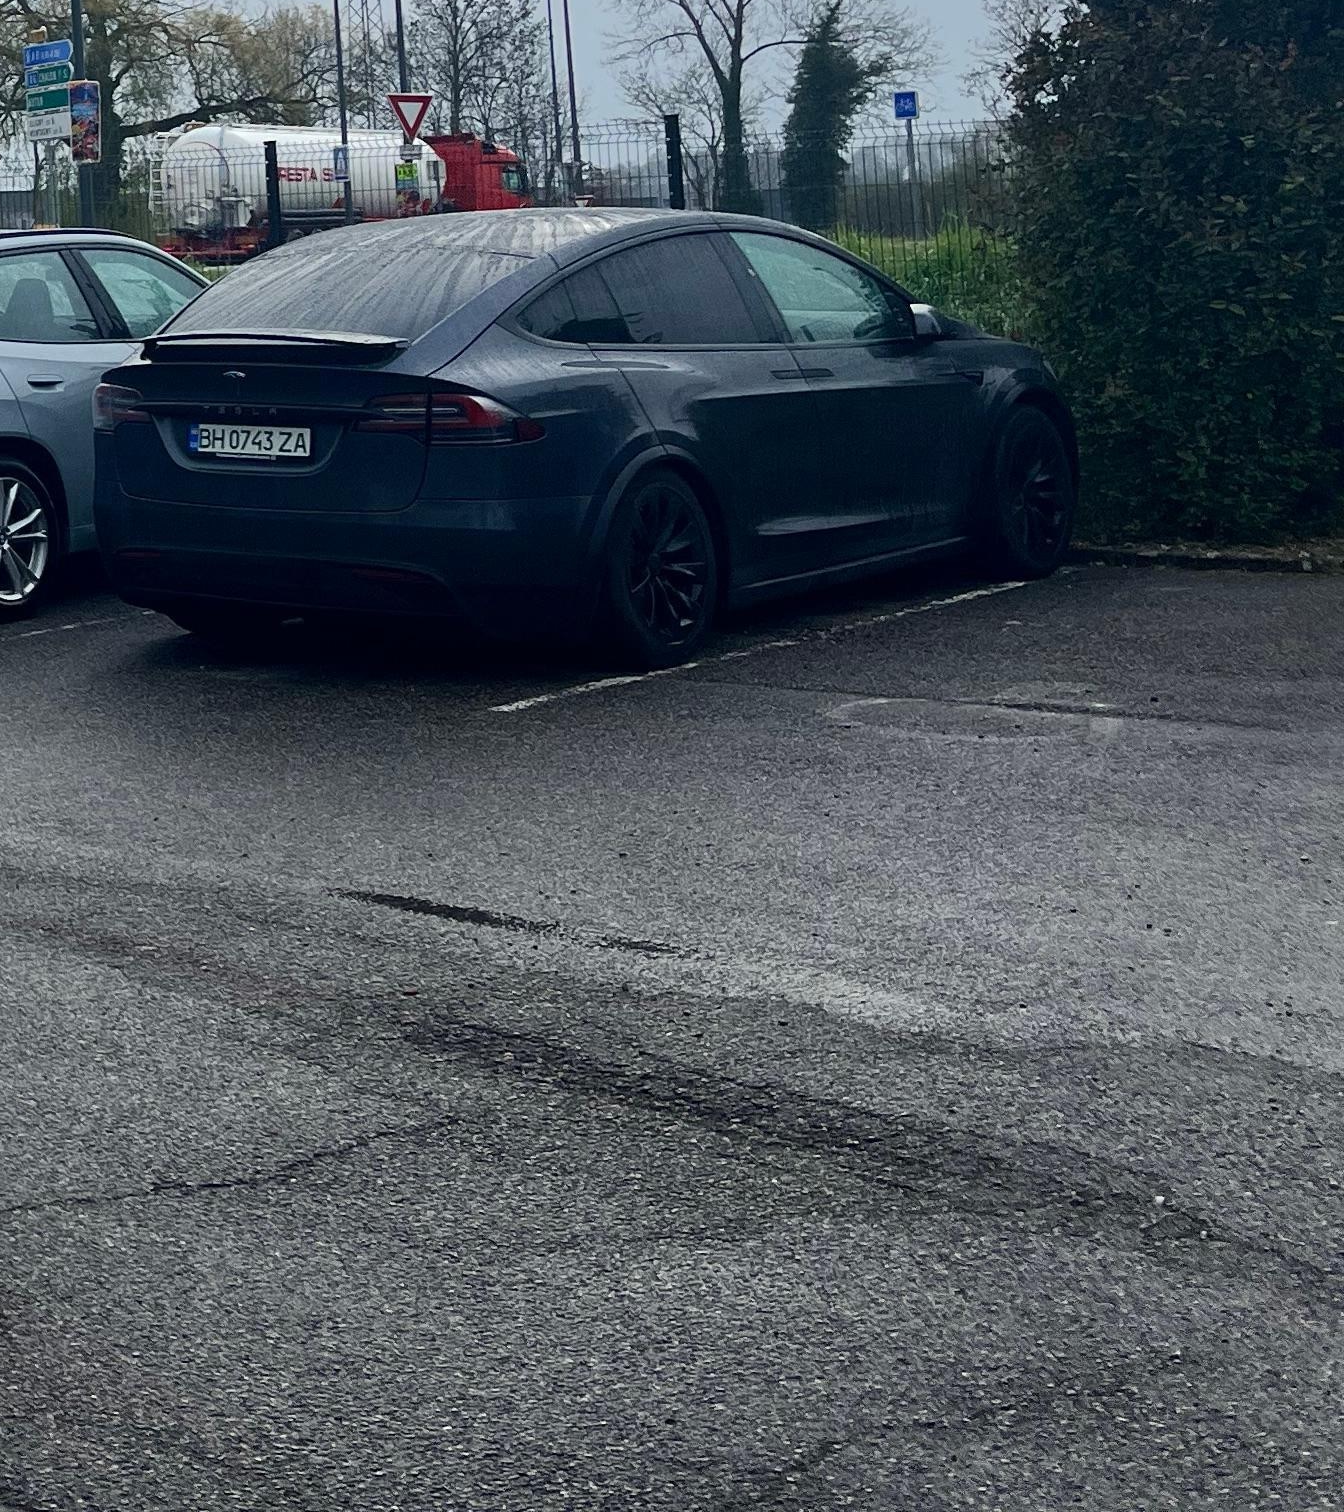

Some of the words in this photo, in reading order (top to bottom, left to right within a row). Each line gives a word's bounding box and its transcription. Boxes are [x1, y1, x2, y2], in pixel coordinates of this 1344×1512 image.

[199, 428, 225, 449] BH
[229, 429, 273, 451] 0743
[278, 432, 307, 453] ZA
